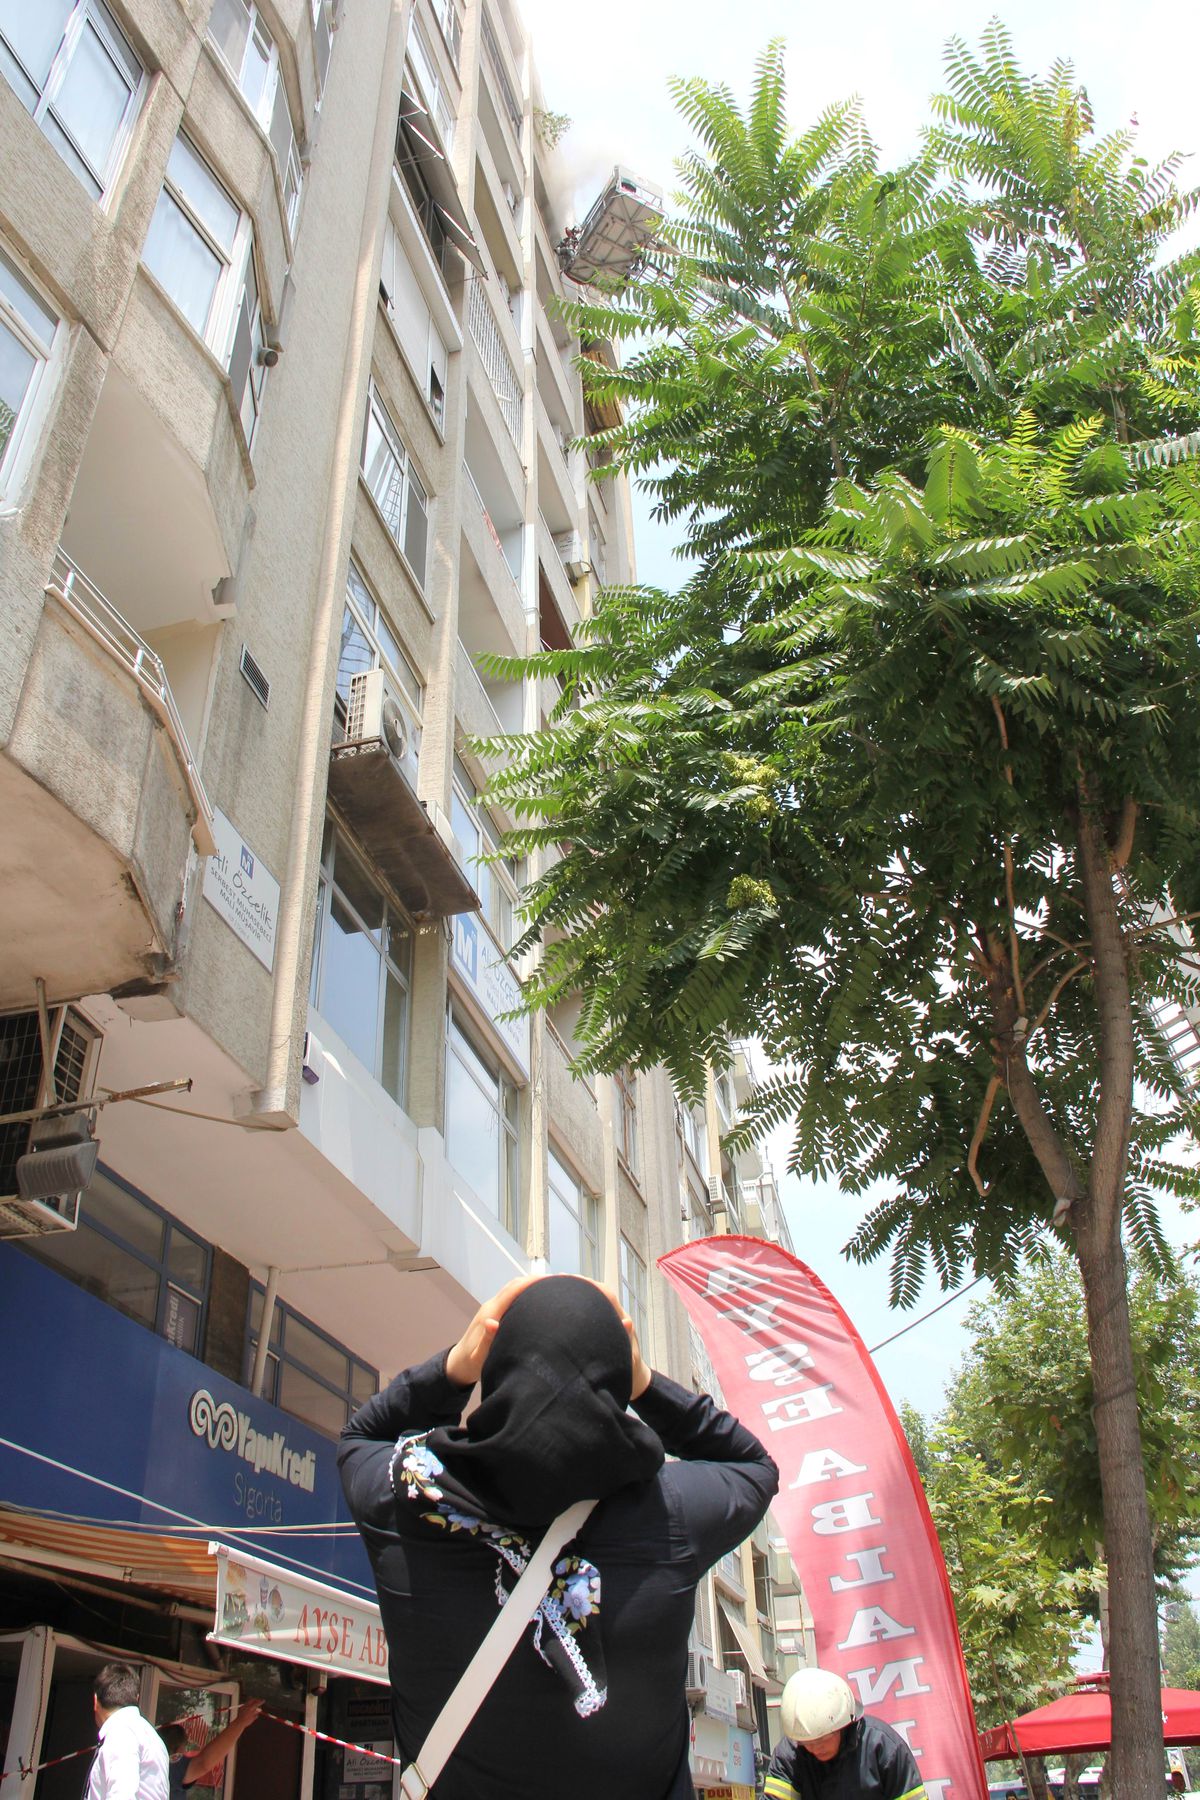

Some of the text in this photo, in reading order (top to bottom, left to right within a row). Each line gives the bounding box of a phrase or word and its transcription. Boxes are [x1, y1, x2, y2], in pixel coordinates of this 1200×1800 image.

[211, 866, 236, 898] SERBEST
[233, 1472, 282, 1522] Sigorta
[293, 1603, 354, 1663] AYŞE
